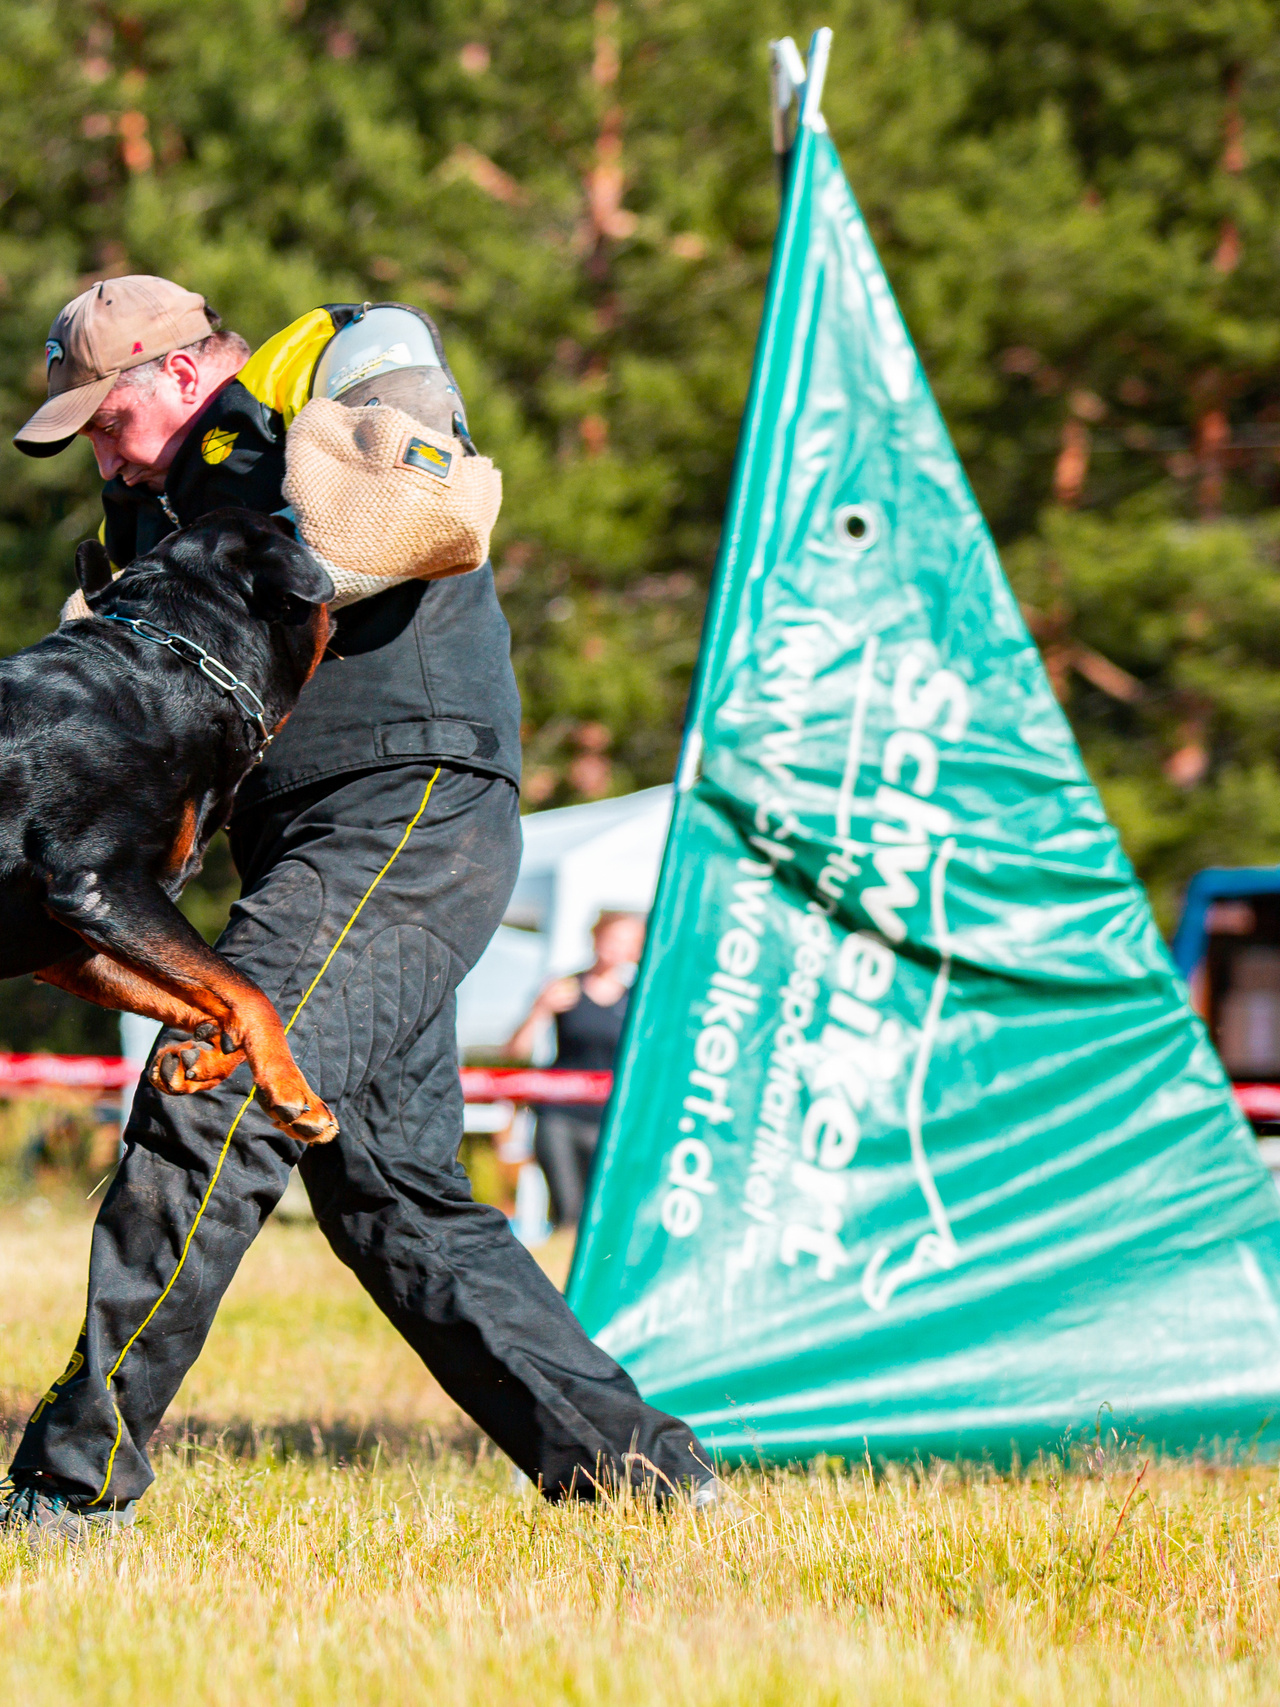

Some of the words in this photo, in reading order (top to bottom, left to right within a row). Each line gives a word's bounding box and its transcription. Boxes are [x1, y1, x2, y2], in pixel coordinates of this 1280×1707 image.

[661, 622, 822, 1239] www.chweikert.de
[741, 837, 867, 1225] Hundesportartikel
[779, 642, 970, 1282] Schweikert
